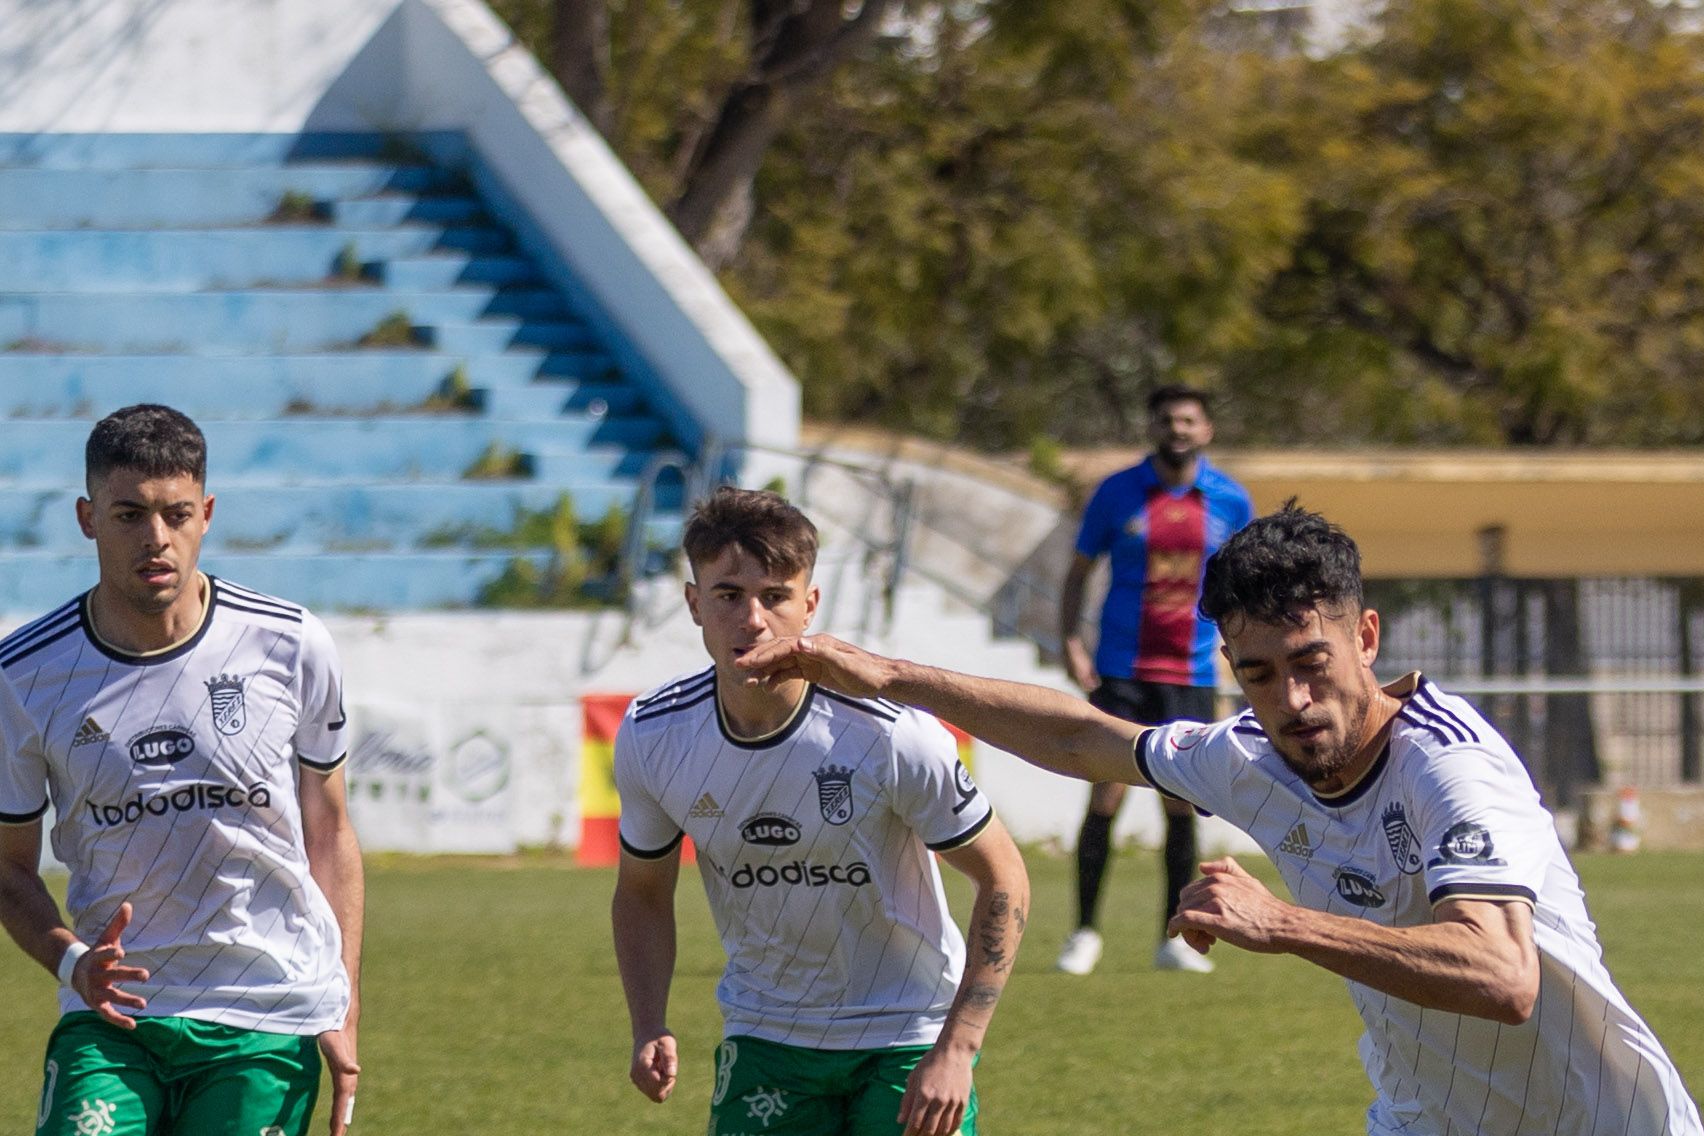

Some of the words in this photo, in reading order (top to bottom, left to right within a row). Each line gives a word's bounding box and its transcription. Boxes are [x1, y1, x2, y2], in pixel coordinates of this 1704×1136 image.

[73, 732, 111, 748] adidas
[132, 738, 193, 760] LUGO
[744, 825, 799, 841] LUGO
[1280, 843, 1314, 859] adidas
